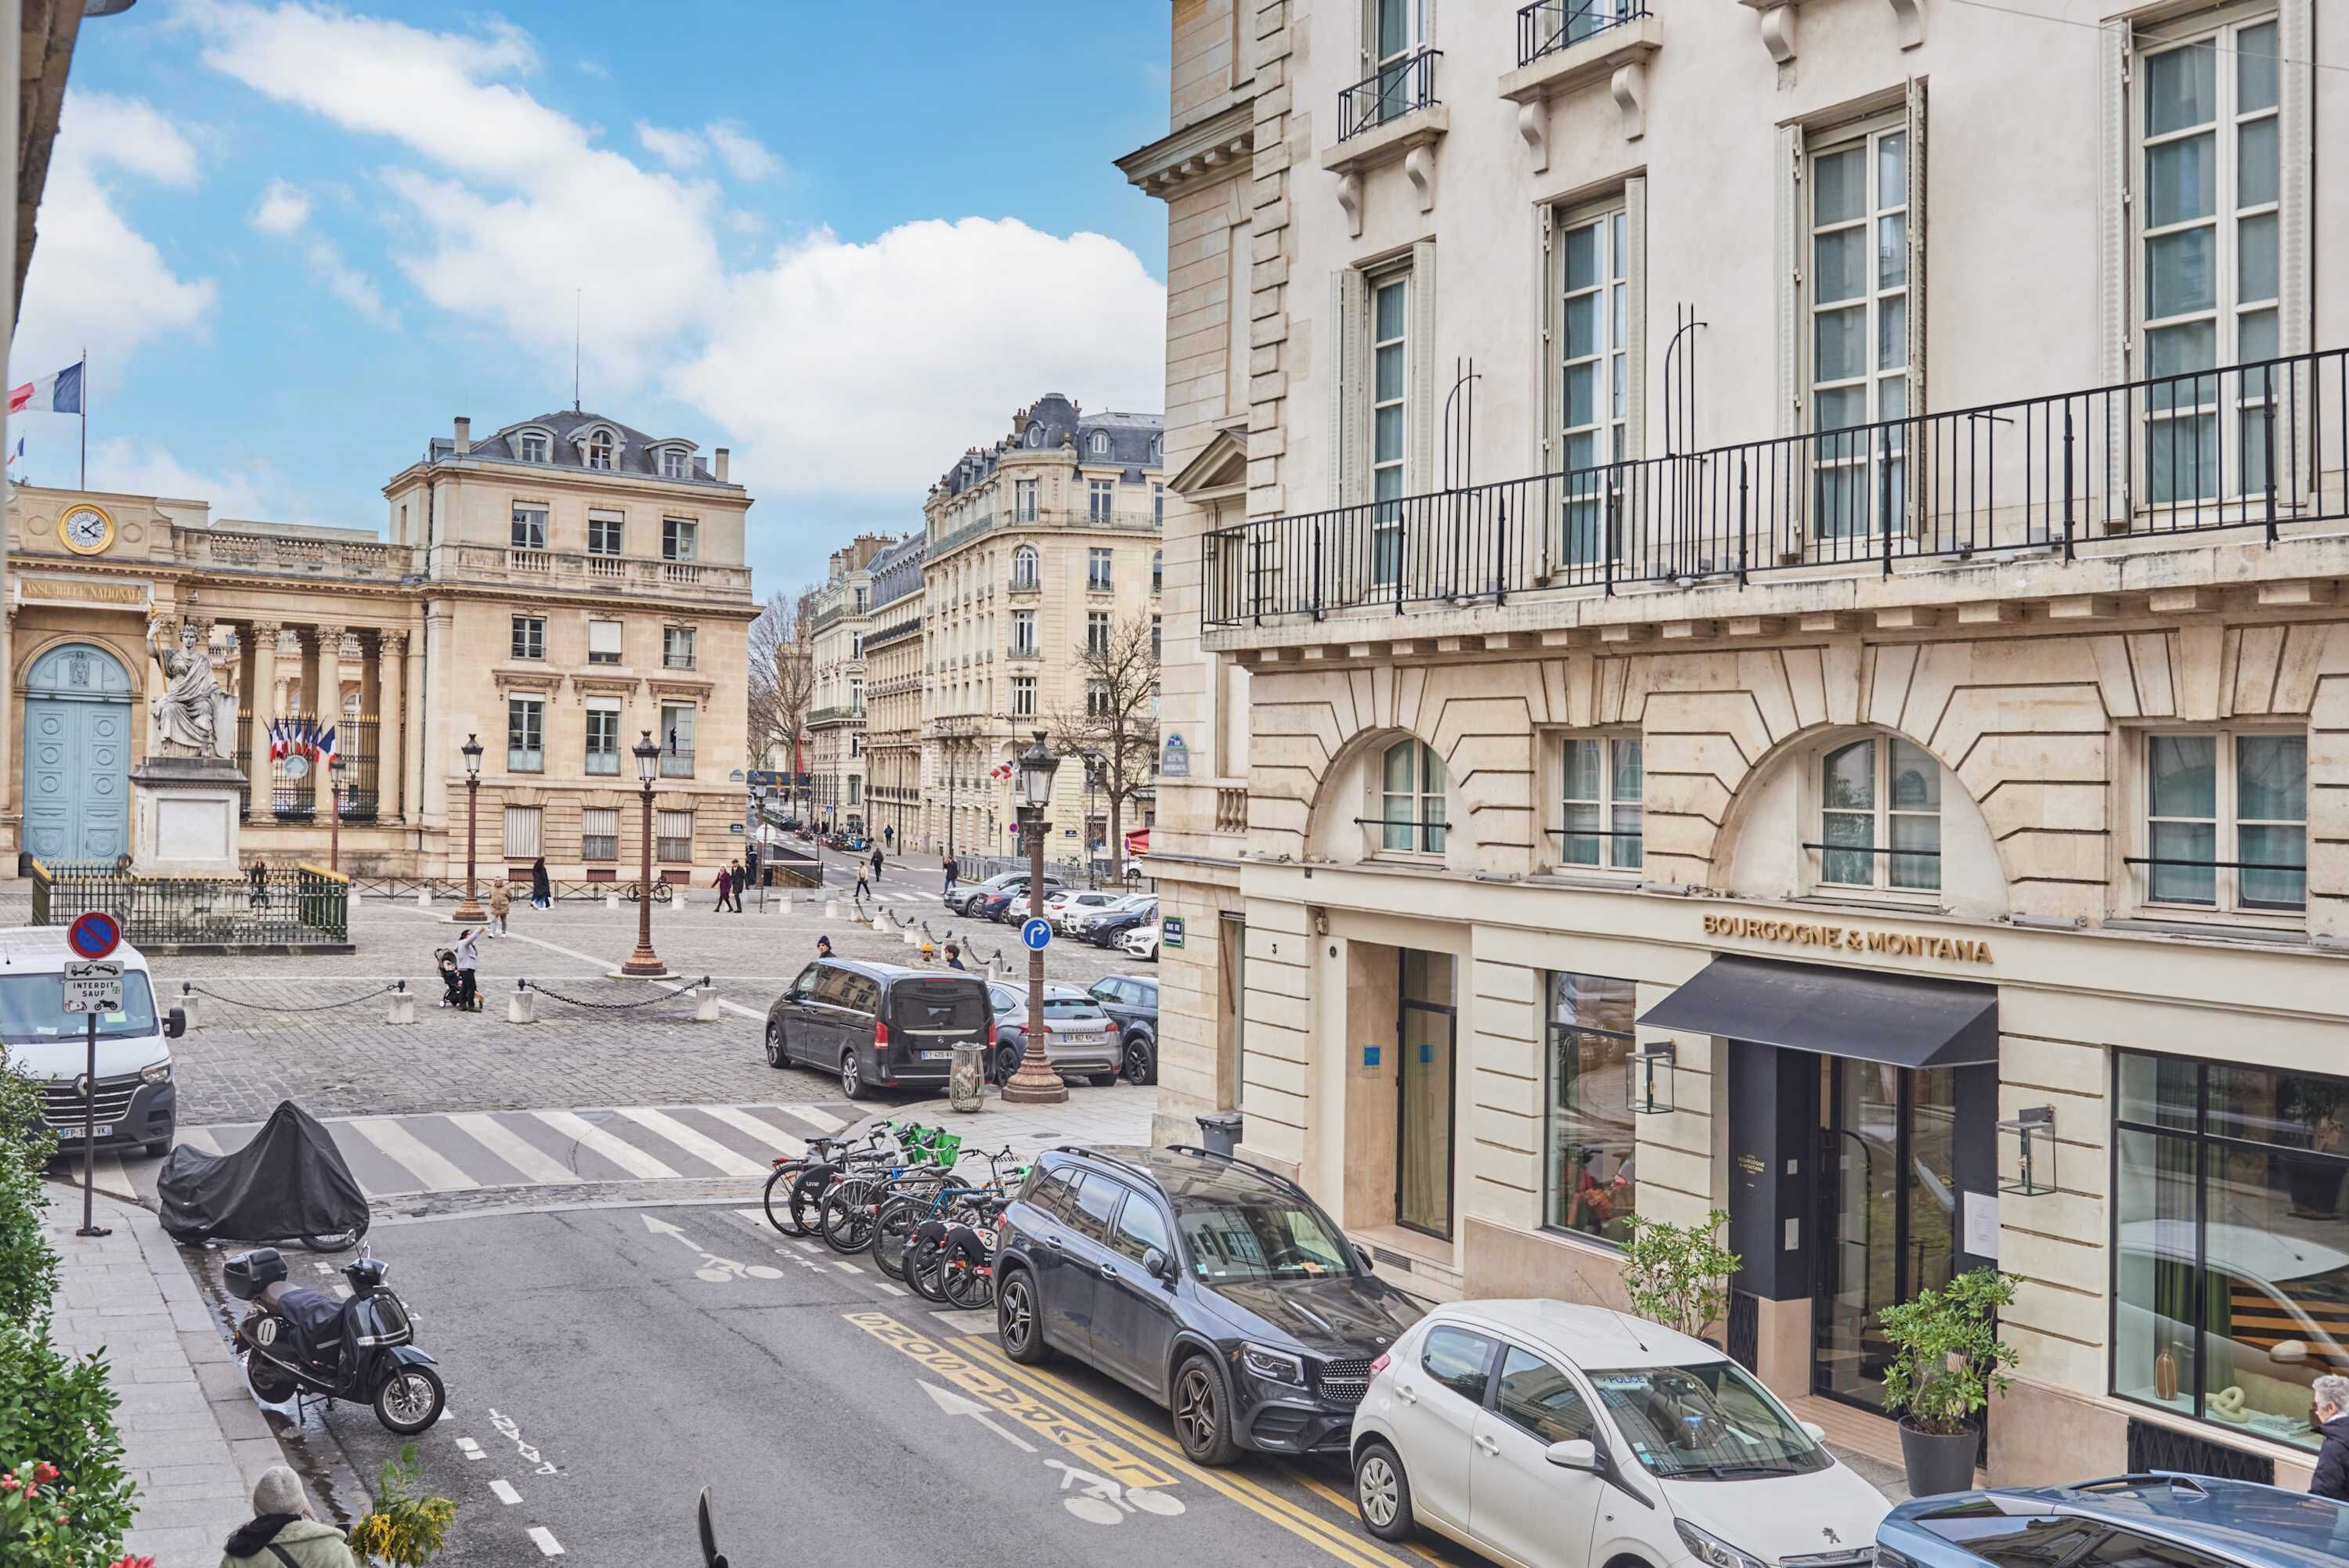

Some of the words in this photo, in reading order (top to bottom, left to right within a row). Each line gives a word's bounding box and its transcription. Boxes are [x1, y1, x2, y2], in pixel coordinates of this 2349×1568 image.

[1703, 914, 1842, 949] BOURGOGNE
[1846, 930, 1864, 952] &
[1867, 932, 1994, 965] MONTANA
[984, 1232, 993, 1246] 3
[260, 1322, 272, 1342] 11
[1608, 1375, 1645, 1384] POLICE
[853, 1313, 1167, 1483] LIVRAISONS
